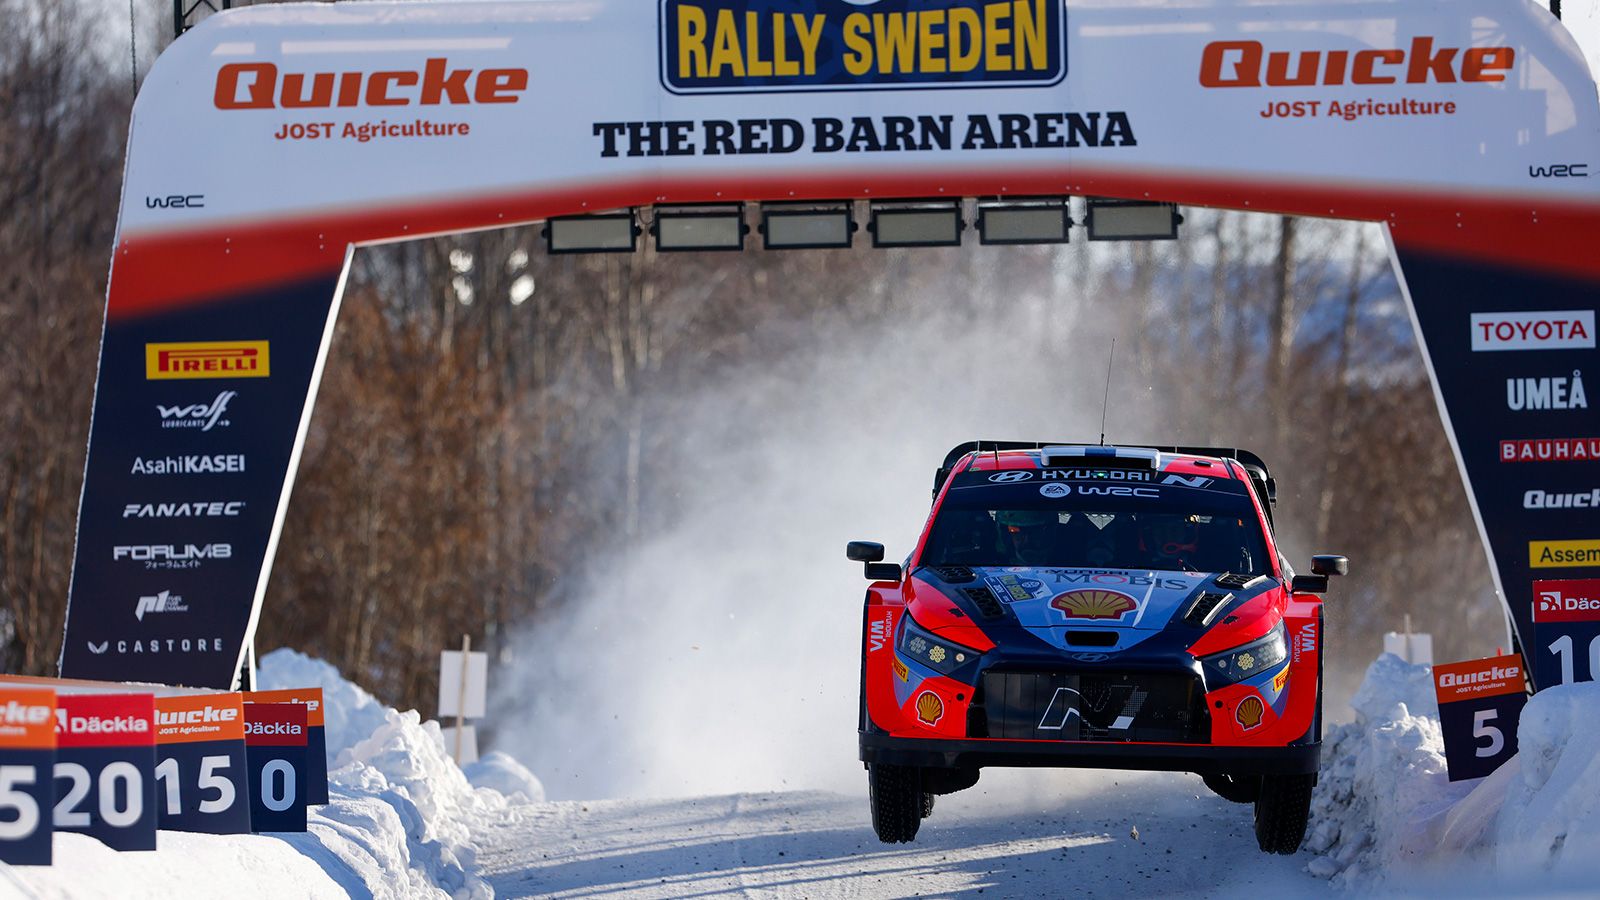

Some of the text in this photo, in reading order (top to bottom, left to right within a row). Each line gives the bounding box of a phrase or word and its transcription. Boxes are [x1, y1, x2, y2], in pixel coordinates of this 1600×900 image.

[677, 0, 1048, 79] RALLY SWEDEN
[1199, 36, 1515, 88] Quicke
[213, 58, 529, 110] Quicke
[1260, 98, 1456, 121] JOST Agriculture
[274, 119, 471, 142] JOST Agriculture
[593, 111, 1137, 158] THE RED BARN ARENA
[1529, 164, 1588, 178] WRC
[146, 194, 205, 209] WRC
[1478, 319, 1588, 341] TOYOTA
[158, 348, 258, 372] PIRELLI
[1506, 369, 1588, 410] UMEÅ
[131, 454, 246, 475] AsahiKASEI
[1041, 469, 1150, 481] HYUNDAI
[1078, 485, 1160, 498] WRC
[123, 501, 241, 518] FANATEC
[113, 543, 232, 561] FORUM8
[1055, 573, 1188, 590] MOBIS
[117, 638, 222, 653] CASTORE
[1439, 666, 1520, 688] Quicke
[1456, 681, 1507, 694] JOST Agriculture
[71, 715, 149, 734] Däckia
[159, 725, 221, 736] JOST Agriculture
[1472, 708, 1505, 758] 5
[52, 761, 144, 829] 20
[154, 754, 237, 816] 15
[261, 758, 296, 812] 0
